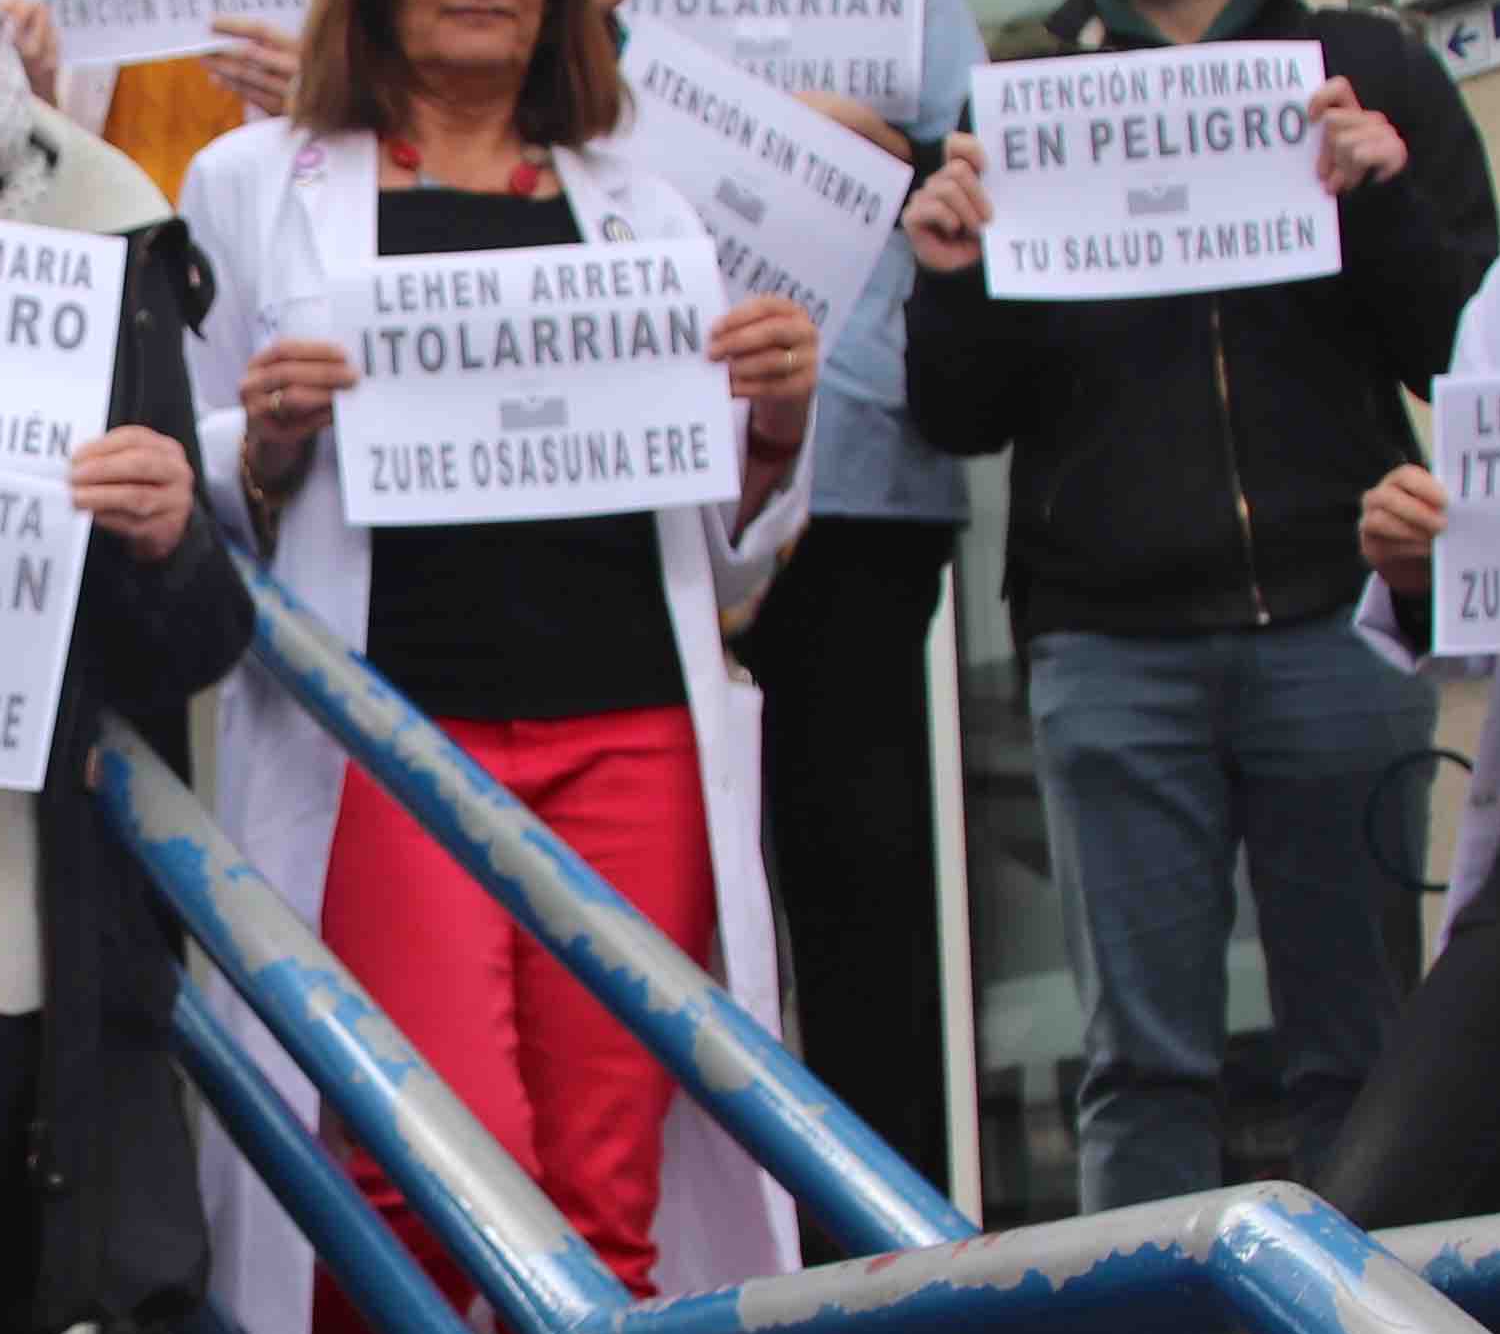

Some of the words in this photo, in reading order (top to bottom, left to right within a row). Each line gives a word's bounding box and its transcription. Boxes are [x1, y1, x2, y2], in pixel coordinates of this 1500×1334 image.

[850, 59, 898, 96] ERE
[1002, 66, 1149, 114] ATENCIÓN
[1162, 57, 1303, 100] PRIMARIA
[1004, 122, 1065, 171] EN
[1090, 104, 1307, 164] PELIGRO
[762, 130, 799, 175] SIN
[804, 154, 882, 226] TIEMPO
[1011, 239, 1048, 273] TU
[1065, 232, 1163, 271] SALUD
[1176, 211, 1316, 262] TAMBIÉN
[373, 268, 501, 314] LEHEN
[531, 257, 681, 301] ARRETA
[363, 306, 699, 377] ITOLARRIAN
[370, 442, 458, 492] ZURE
[472, 432, 633, 486] OSASUNA
[647, 424, 709, 475] ERE
